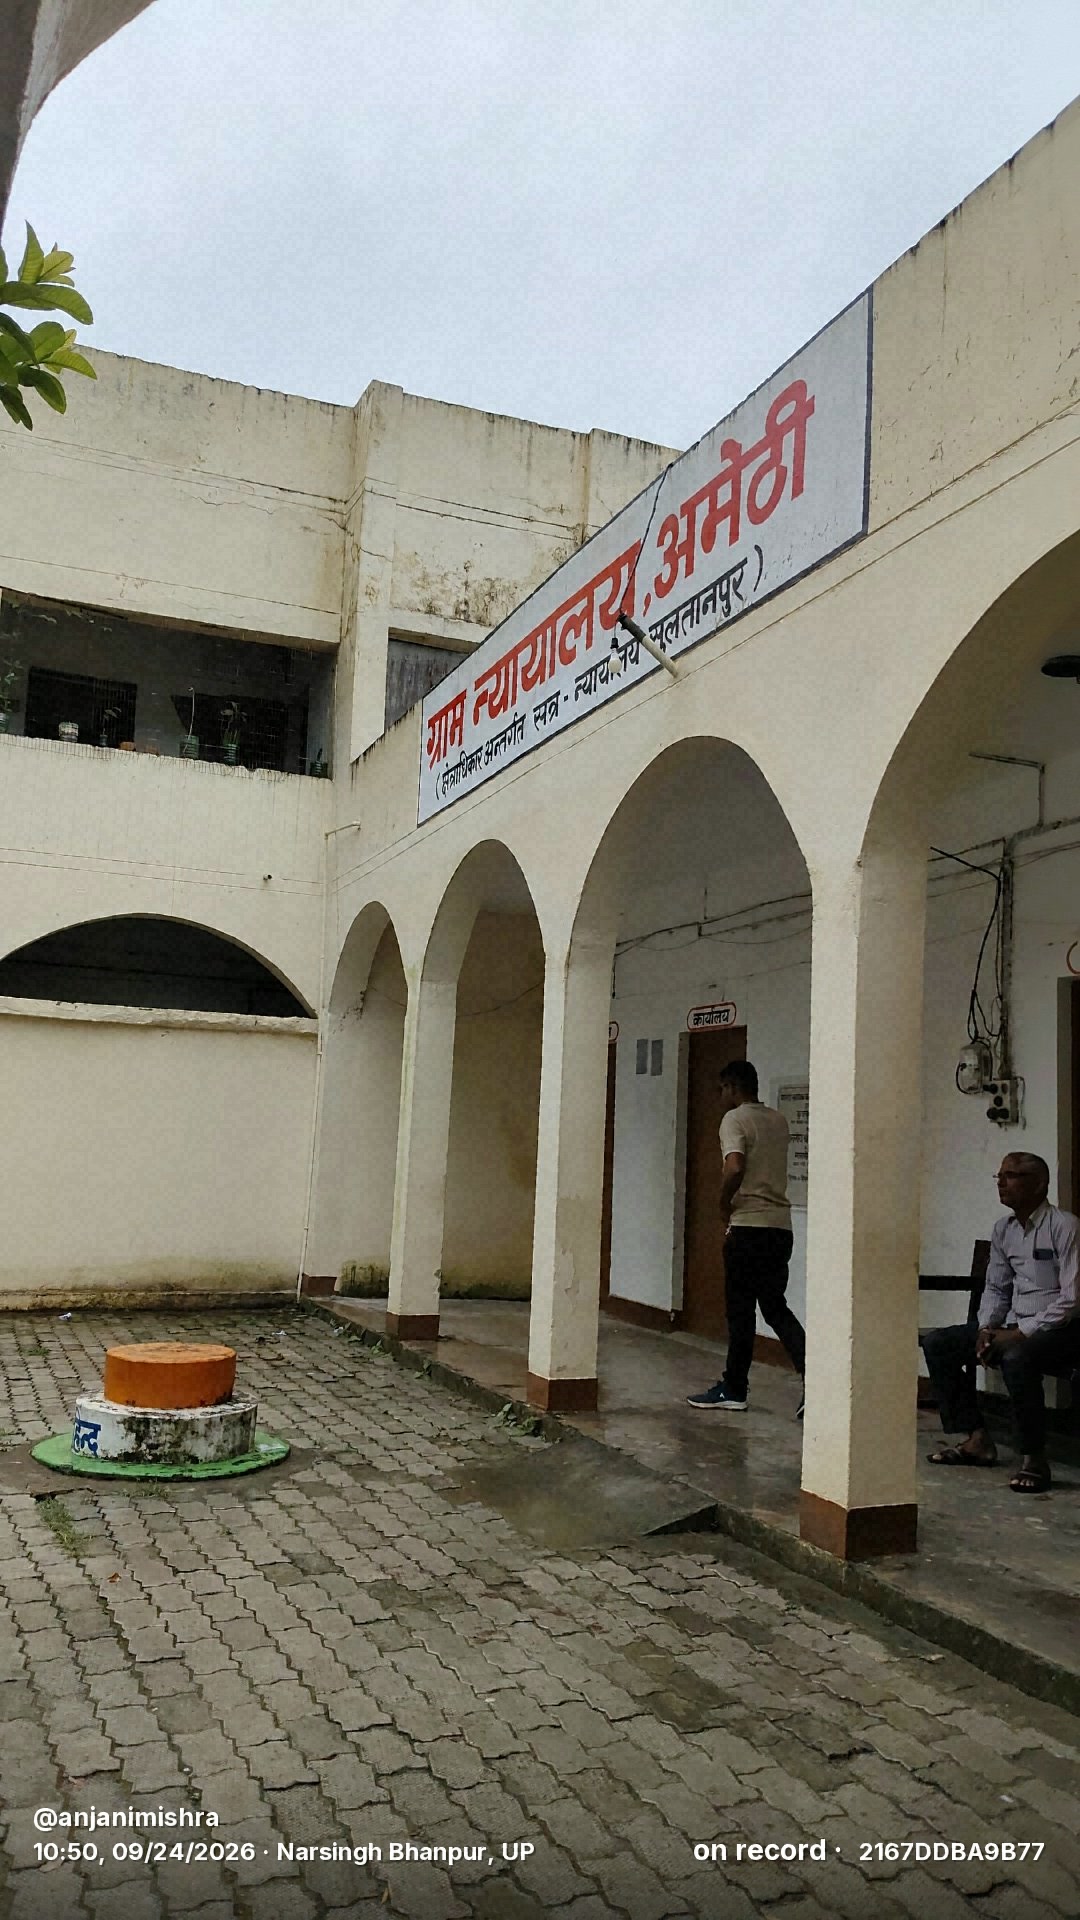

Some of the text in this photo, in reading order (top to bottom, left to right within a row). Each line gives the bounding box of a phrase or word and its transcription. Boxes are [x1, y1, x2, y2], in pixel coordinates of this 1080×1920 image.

[427, 687, 467, 770] ग्राम
[654, 379, 815, 599] अमेठी
[693, 1005, 730, 1026] कार्यालय
